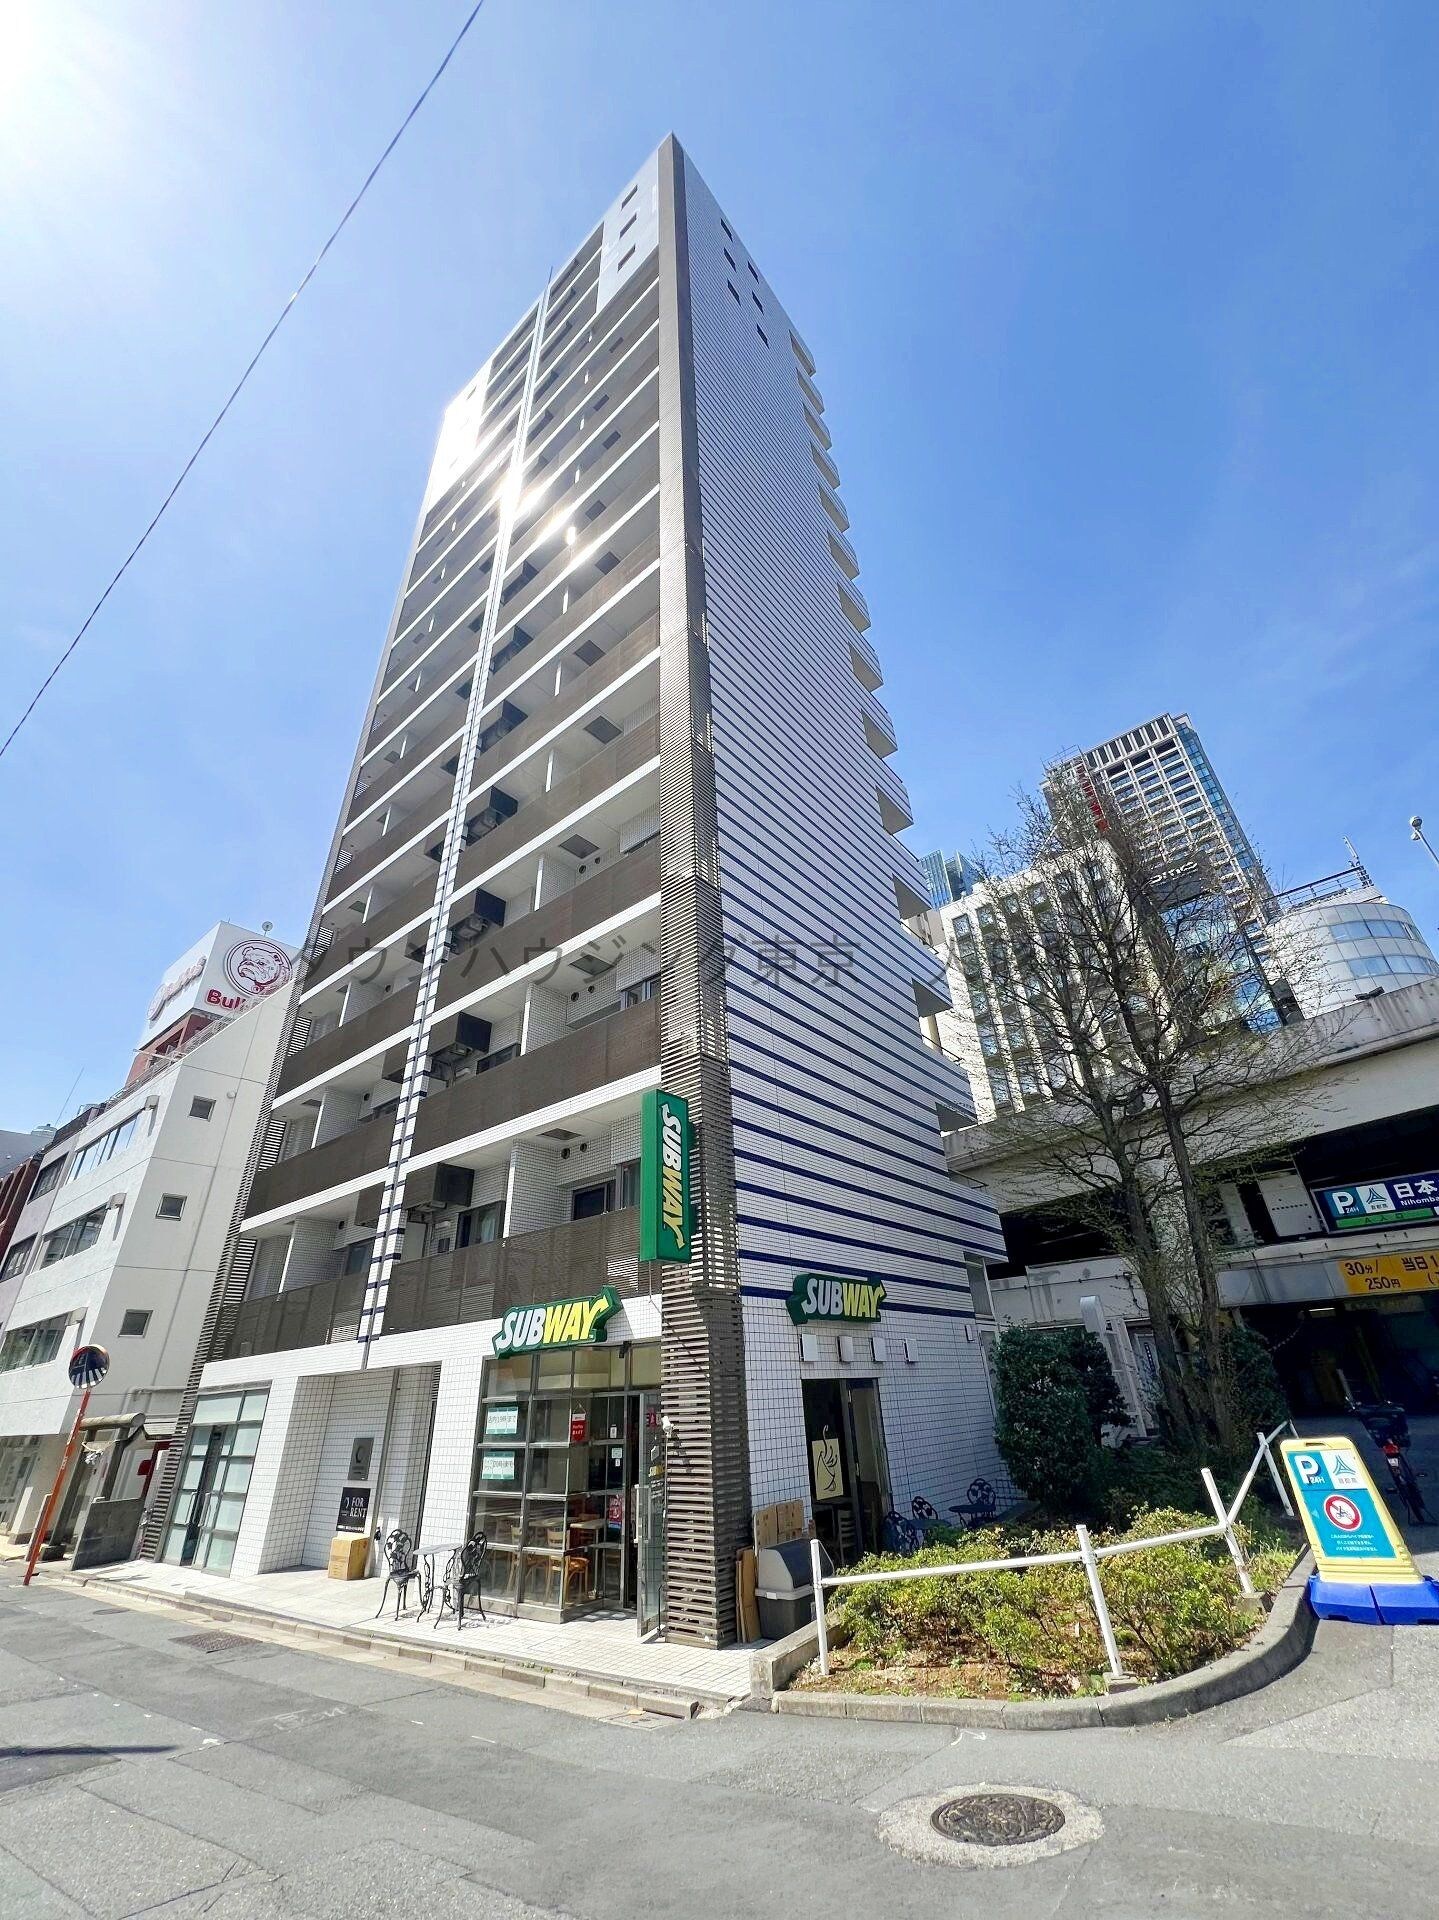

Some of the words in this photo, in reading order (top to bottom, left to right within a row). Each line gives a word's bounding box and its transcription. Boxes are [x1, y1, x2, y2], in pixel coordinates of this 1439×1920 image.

[661, 1103, 685, 1249] SUBWAY
[1394, 1179, 1438, 1199] 日本
[1332, 1191, 1354, 1214] P
[1365, 1276, 1401, 1290] 250円
[800, 1278, 885, 1318] SUBWAY
[494, 1295, 610, 1350] SUBWAY
[1294, 1455, 1319, 1484] P
[350, 1507, 368, 1518] RENT
[351, 1496, 364, 1507] FOR
